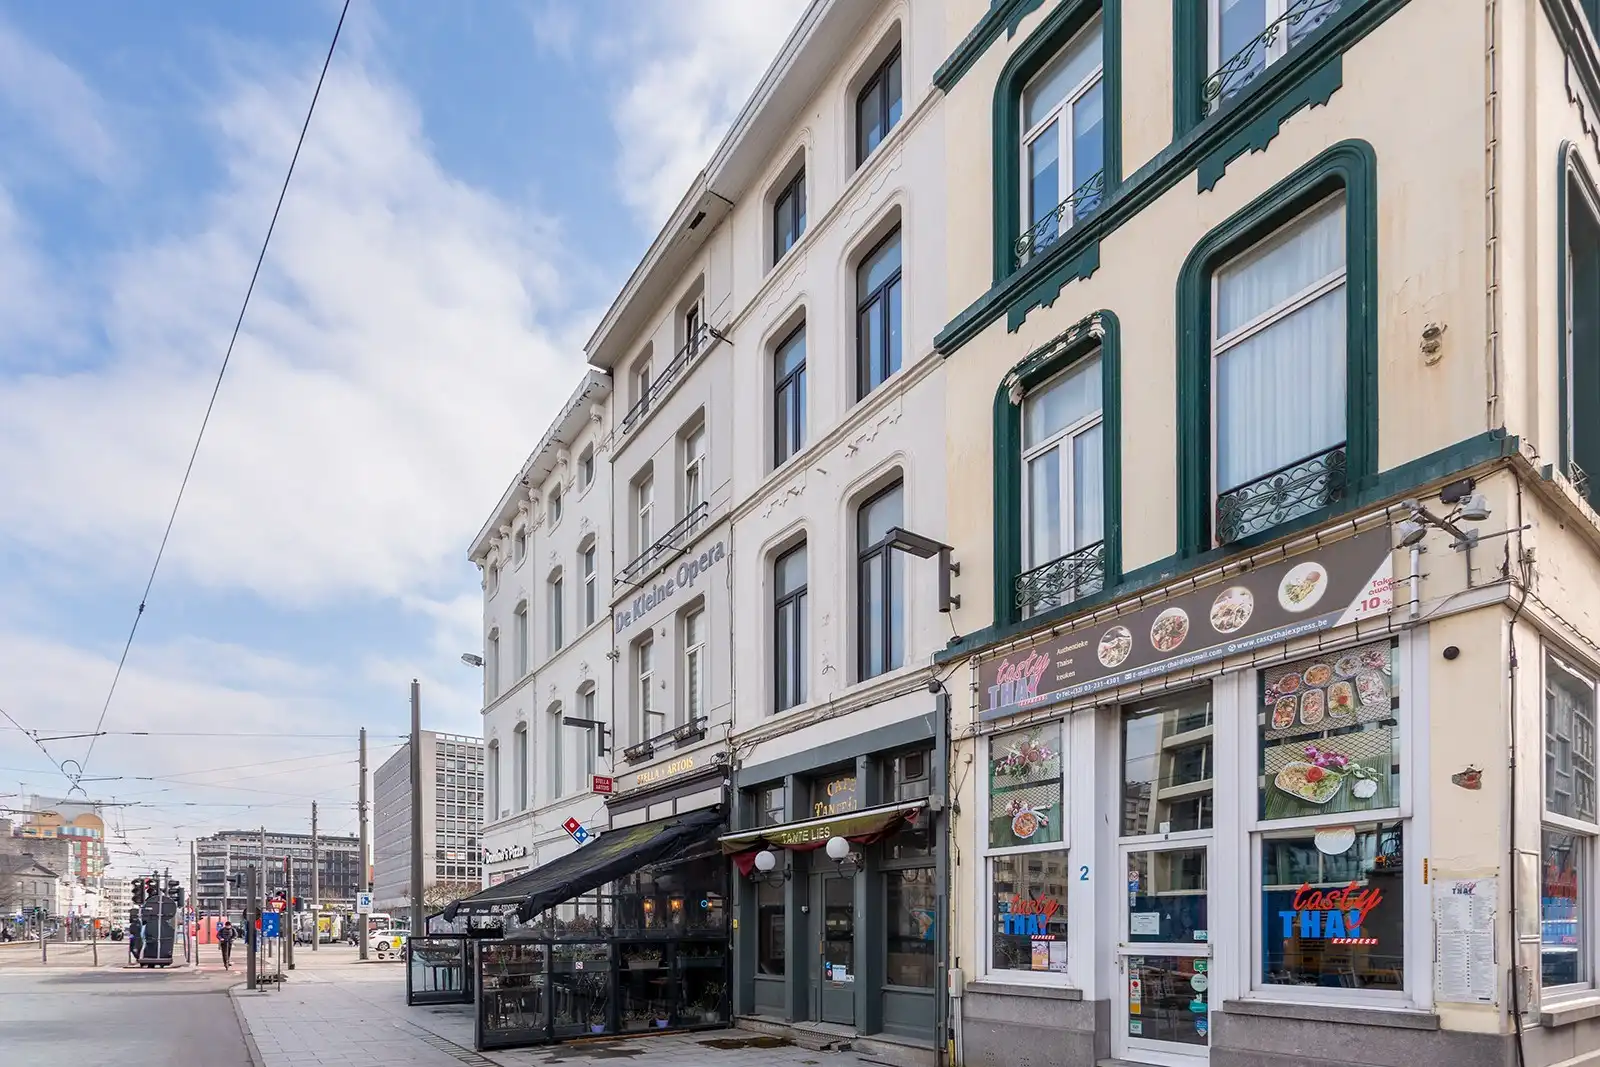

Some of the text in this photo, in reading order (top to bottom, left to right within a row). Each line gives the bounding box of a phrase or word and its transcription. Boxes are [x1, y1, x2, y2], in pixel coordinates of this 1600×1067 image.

[615, 541, 725, 634] De Kleine Opera
[1057, 640, 1089, 655] Authentieke
[997, 649, 1050, 685] tasty
[1057, 658, 1073, 668] Thaise
[1057, 671, 1076, 681] keuken
[988, 675, 1038, 710] THAI
[637, 757, 694, 785] STELLA ARTOIS
[781, 826, 830, 844] TANTE LIES
[1079, 865, 1090, 881] 2
[1011, 891, 1060, 928] tasty
[1293, 880, 1383, 930] tasty
[1003, 914, 1047, 936] THAI
[1279, 908, 1361, 938] THAI
